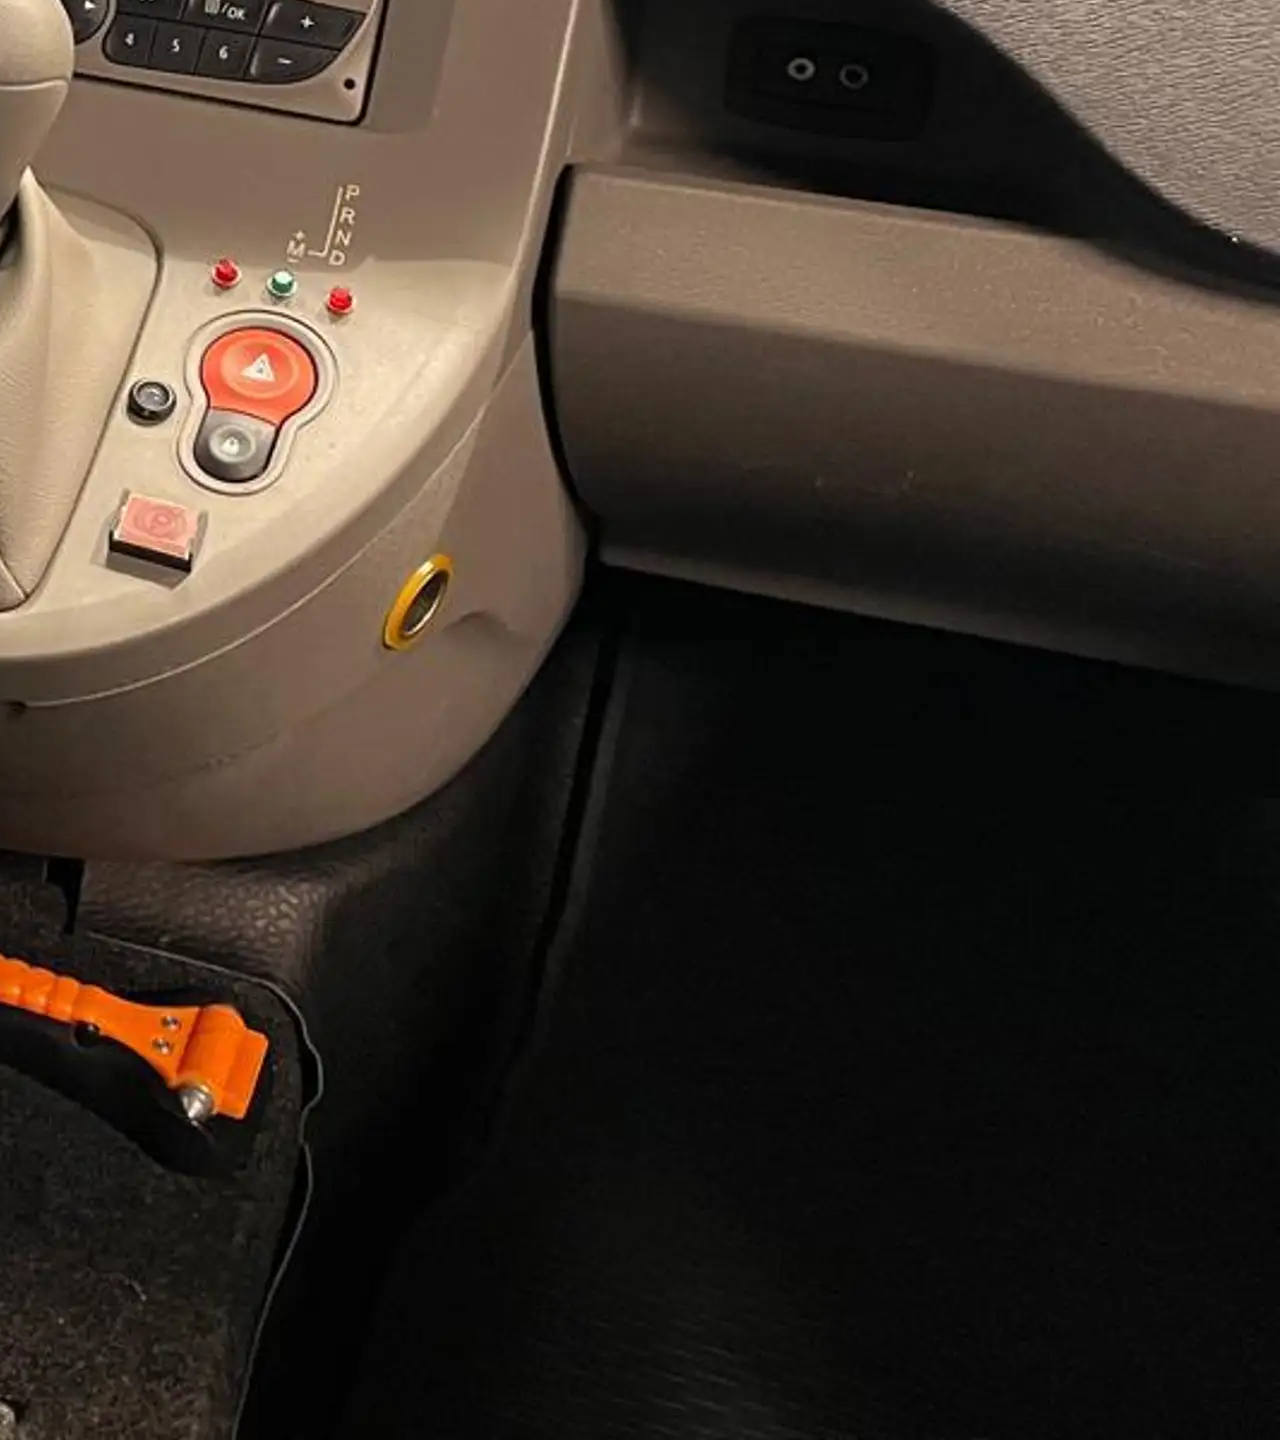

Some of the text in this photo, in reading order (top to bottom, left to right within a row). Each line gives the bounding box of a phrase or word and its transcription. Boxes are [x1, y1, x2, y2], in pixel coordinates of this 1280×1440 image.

[124, 32, 229, 60] 4 5 6
[344, 184, 360, 201] P
[339, 206, 356, 225] R
[334, 229, 352, 247] N
[328, 249, 346, 266] D
